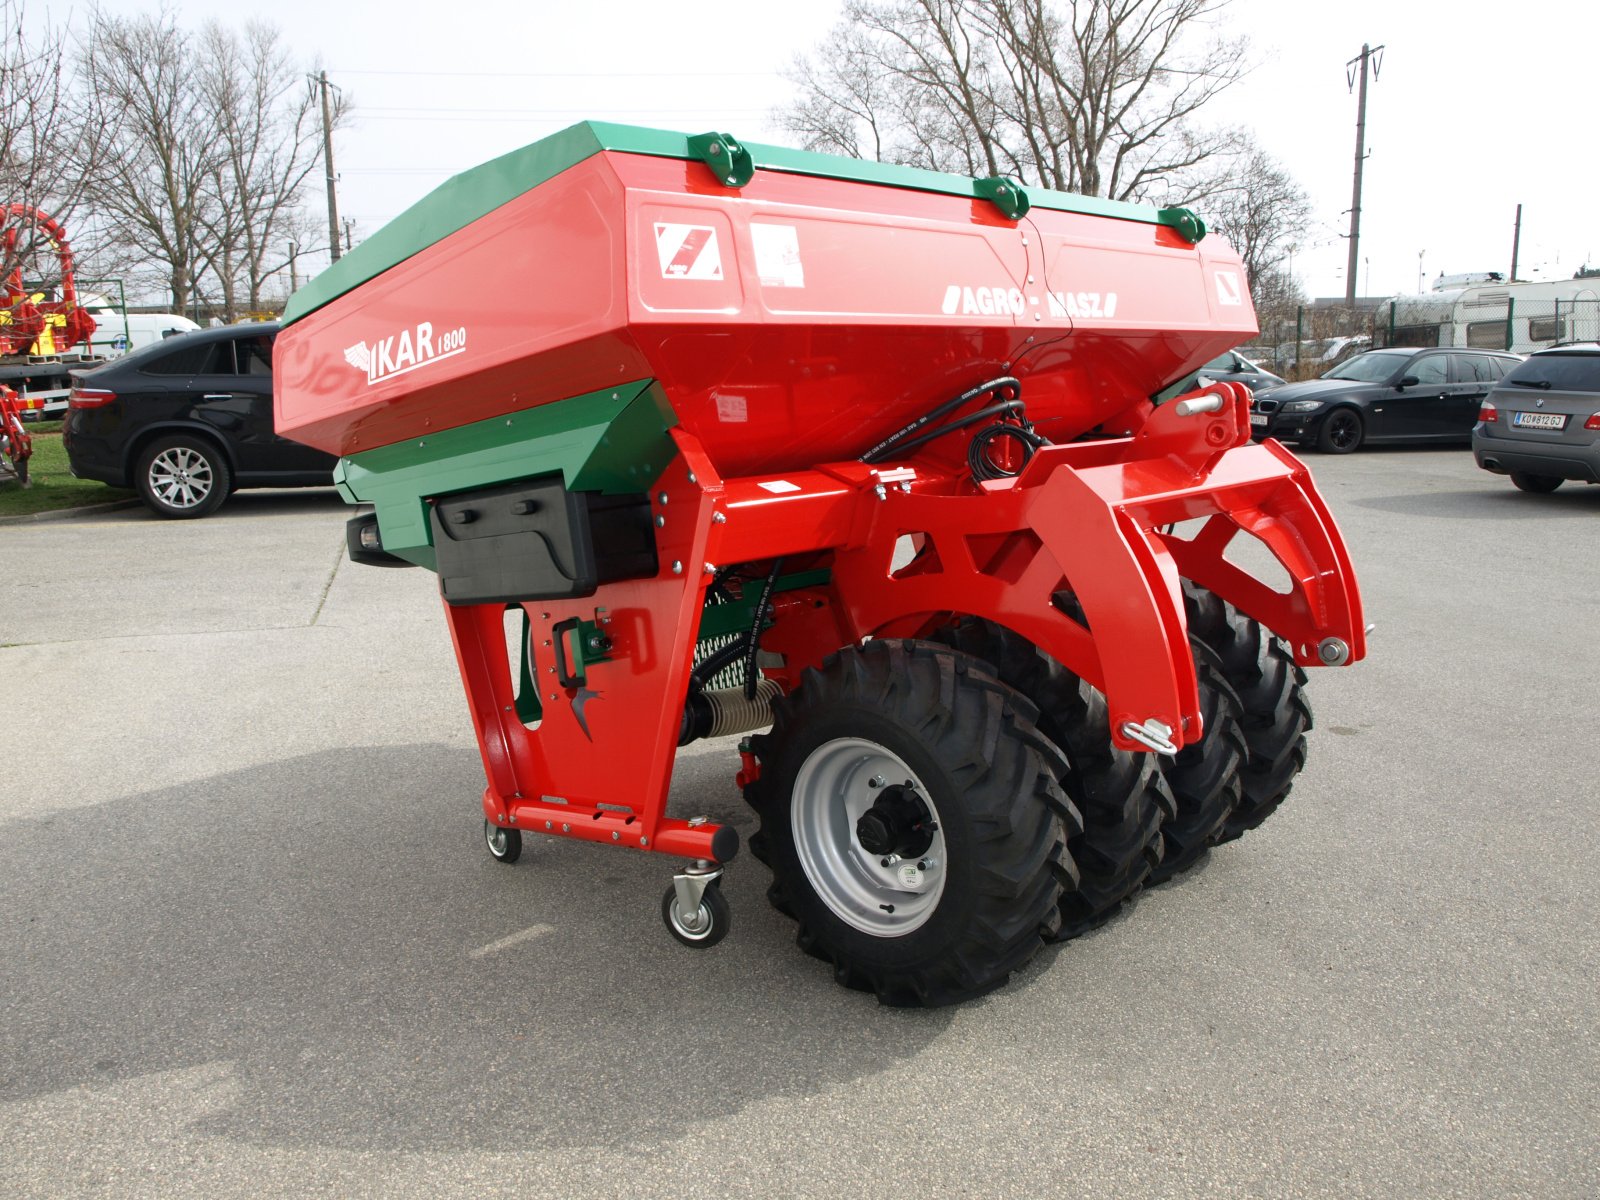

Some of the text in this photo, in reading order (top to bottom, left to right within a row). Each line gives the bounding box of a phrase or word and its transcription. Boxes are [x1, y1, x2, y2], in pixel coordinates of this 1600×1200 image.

[962, 286, 1025, 315] AGRO
[1046, 292, 1105, 318] MASZ
[369, 321, 466, 380] IKAR 1800
